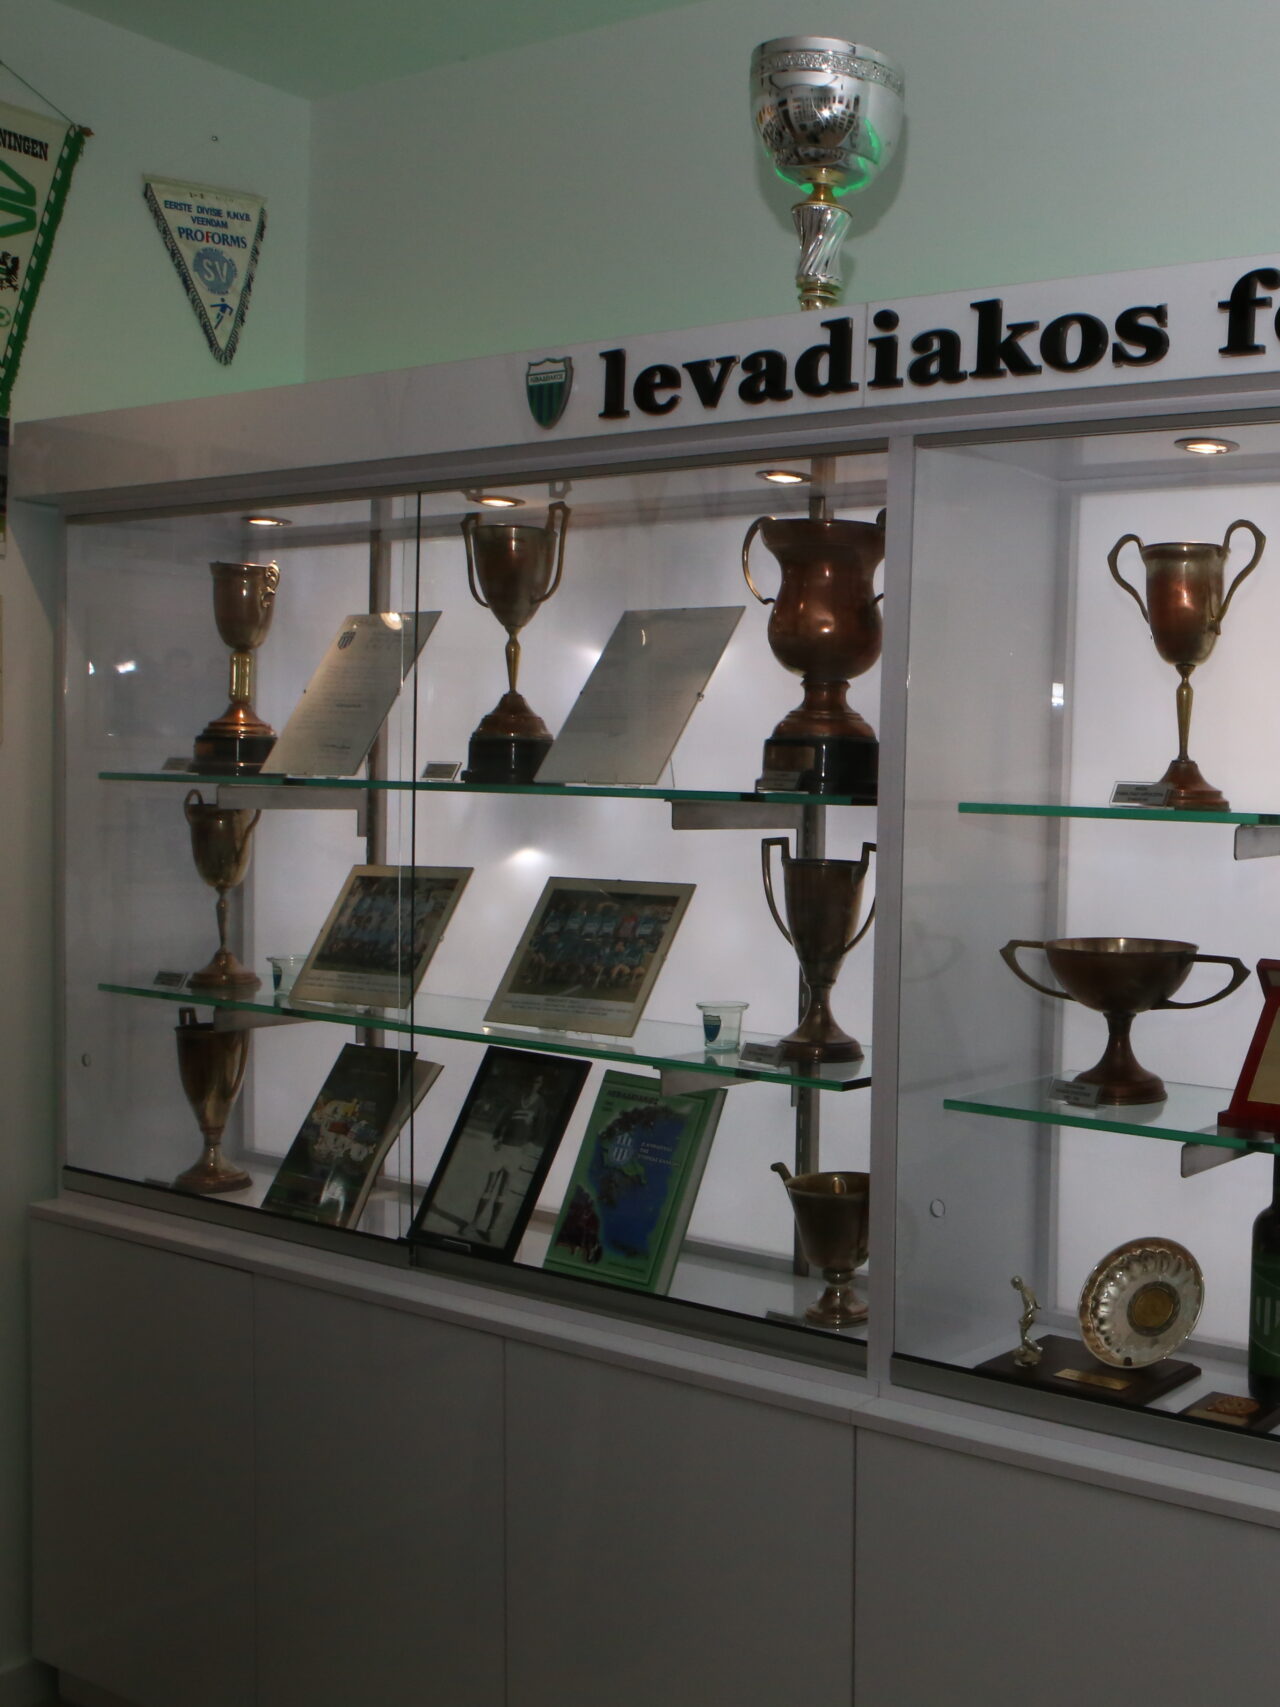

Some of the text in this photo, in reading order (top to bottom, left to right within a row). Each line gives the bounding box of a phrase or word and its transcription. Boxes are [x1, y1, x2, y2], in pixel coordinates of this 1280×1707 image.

[164, 200, 192, 213] EERSTE
[191, 215, 228, 229] VEENDAM
[177, 226, 247, 249] PROFORMS
[202, 259, 228, 283] SV
[598, 298, 1170, 419] levadiakos
